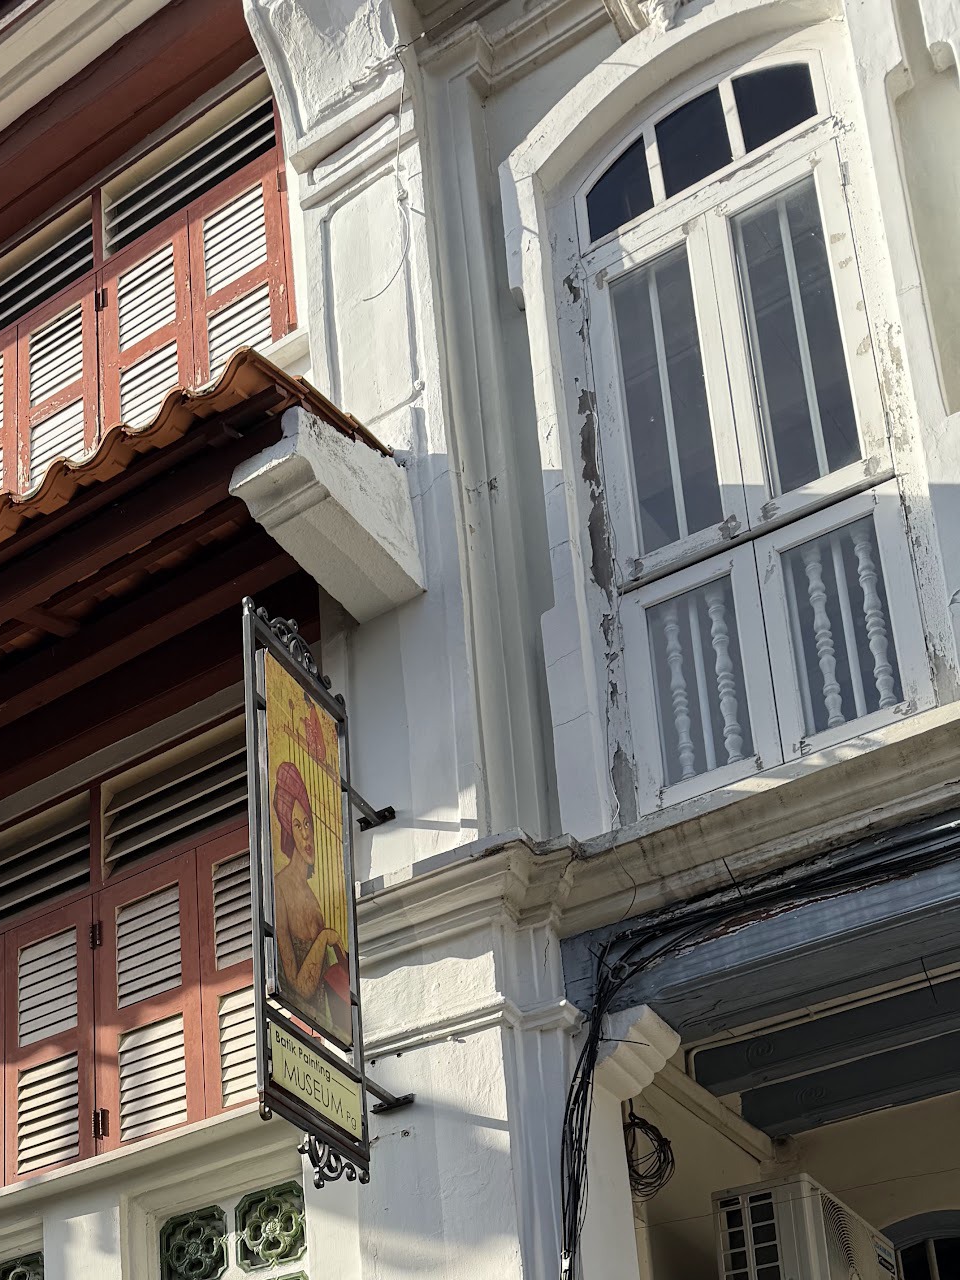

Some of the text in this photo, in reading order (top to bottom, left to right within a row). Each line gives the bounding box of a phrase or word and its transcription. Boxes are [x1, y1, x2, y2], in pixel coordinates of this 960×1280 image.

[275, 1030, 331, 1083] Batik Painting
[283, 1058, 344, 1119] MUSEUM
